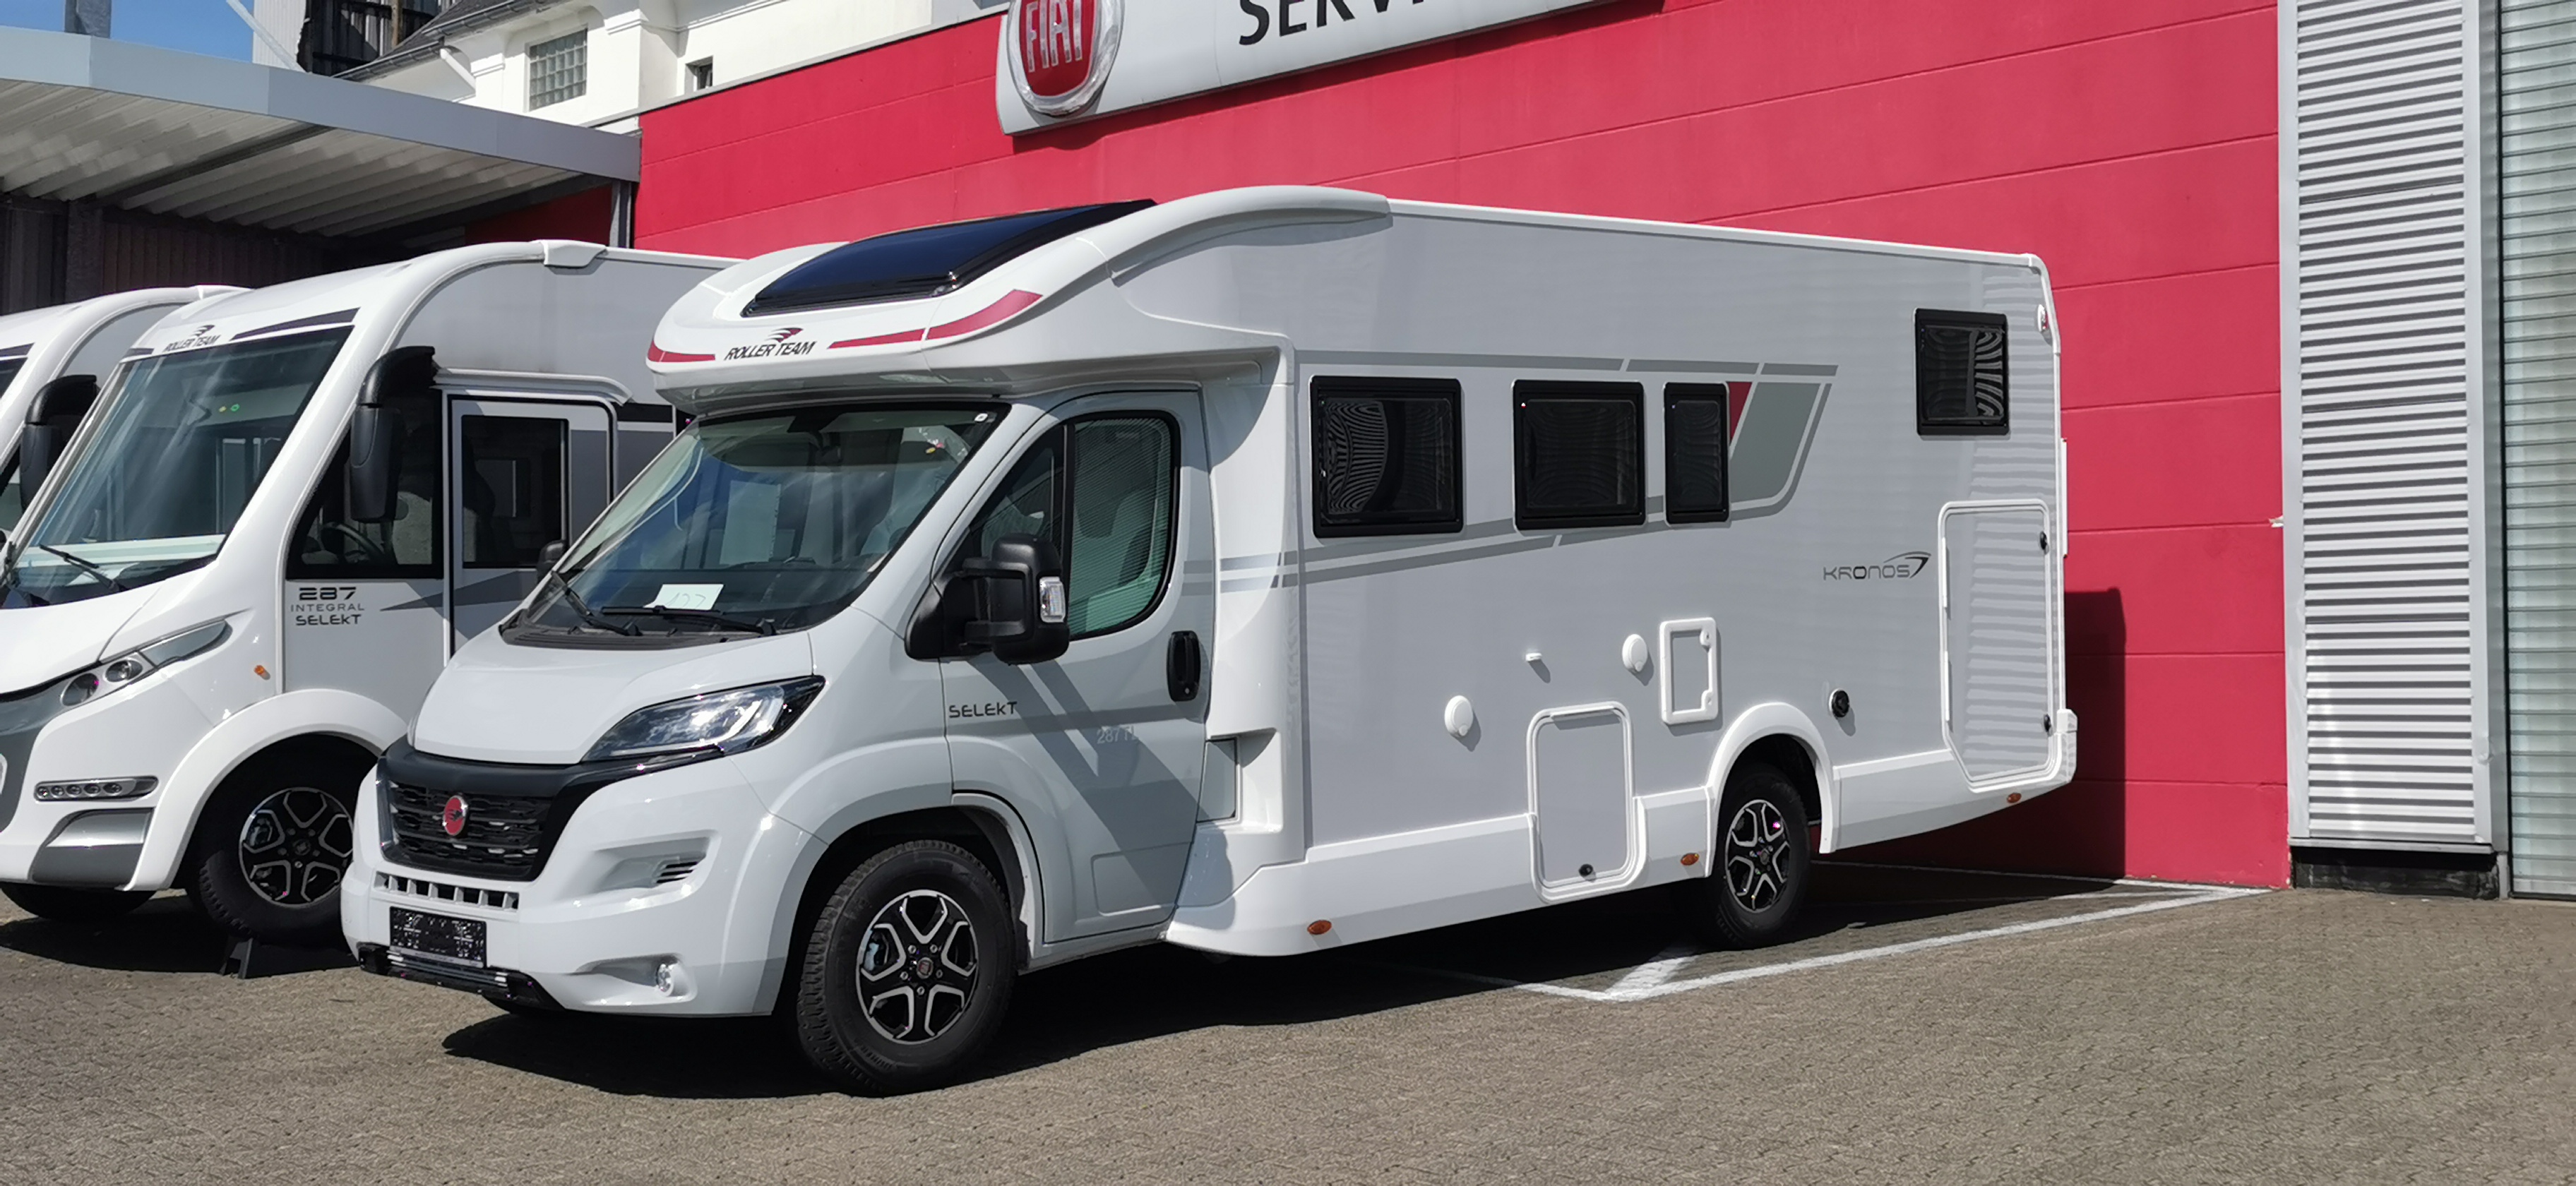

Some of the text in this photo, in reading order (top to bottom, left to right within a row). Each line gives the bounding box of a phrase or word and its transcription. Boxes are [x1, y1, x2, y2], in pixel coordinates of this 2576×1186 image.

[1026, 0, 1083, 73] FIAT
[192, 334, 221, 348] TEAM
[724, 341, 817, 361] ROLLER TEAM
[1823, 565, 1910, 580] KRONOS
[299, 587, 357, 601] 287
[290, 603, 364, 612] INTEGRAL
[296, 613, 362, 626] SELEKT
[949, 701, 1018, 719] SELEKT
